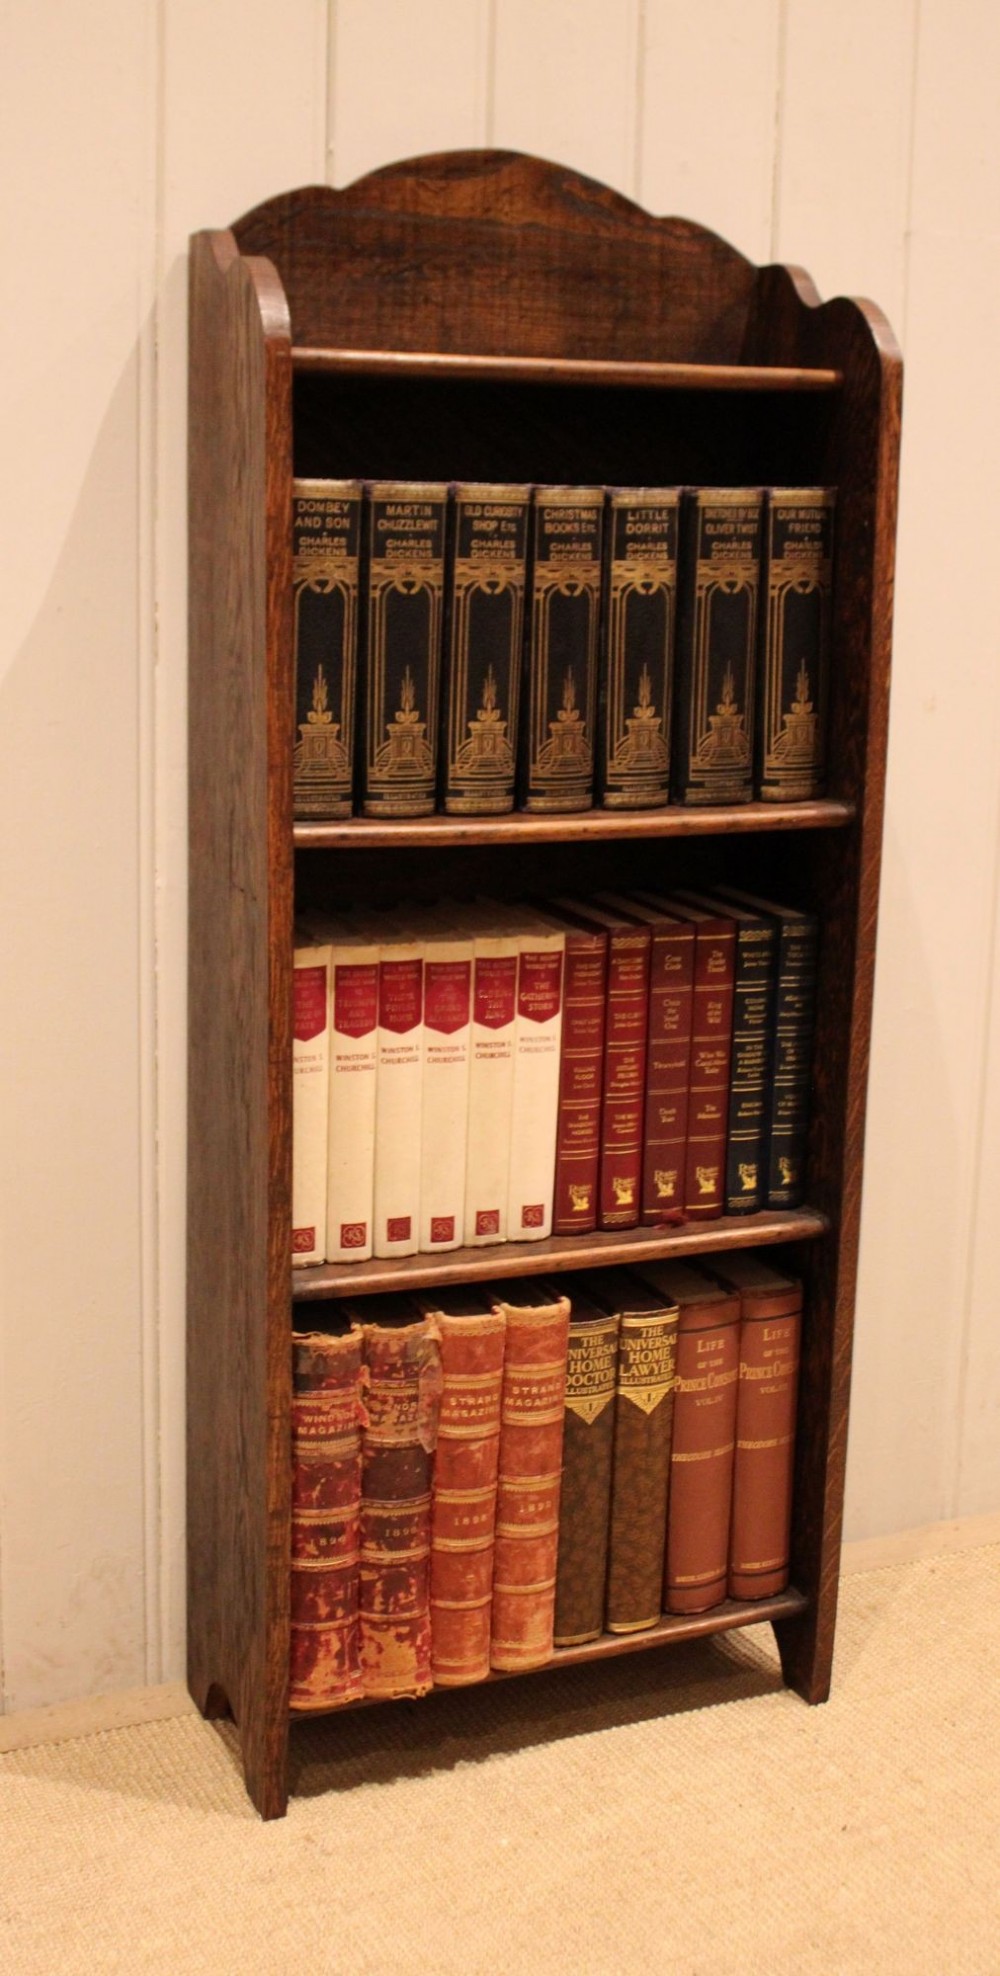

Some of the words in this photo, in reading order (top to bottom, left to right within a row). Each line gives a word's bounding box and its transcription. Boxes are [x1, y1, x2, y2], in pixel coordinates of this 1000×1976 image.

[297, 501, 350, 513] DOMBEY
[386, 505, 432, 516] MARTIN
[544, 508, 597, 520] CHRISTMAS
[627, 510, 669, 521] LITTLE
[295, 517, 321, 528] AND
[325, 517, 350, 528] SON
[377, 519, 437, 531] CHUZZLEWIT
[472, 520, 498, 531] SHOP
[544, 522, 580, 534] BOOKS
[626, 523, 669, 534] DORRIT
[299, 537, 347, 546] CHARLES
[385, 539, 432, 548] CHARLES
[470, 539, 516, 549] CHARLES
[549, 542, 592, 551] CHARLES
[626, 542, 668, 551] CHARLES
[711, 541, 752, 550] CHARLES
[299, 547, 347, 556] DICKENS
[385, 549, 433, 558] DICKENS
[470, 549, 516, 558] DICKENS
[549, 552, 592, 560] DICKENS
[640, 1326, 664, 1338] THE
[581, 1335, 605, 1347] THE
[568, 1344, 617, 1360] NIVERSA
[628, 1347, 671, 1364] HOME
[569, 1356, 612, 1373] HOME
[619, 1359, 675, 1377] LAWYER
[512, 1382, 561, 1395] STRAND
[450, 1393, 499, 1406] STRAND
